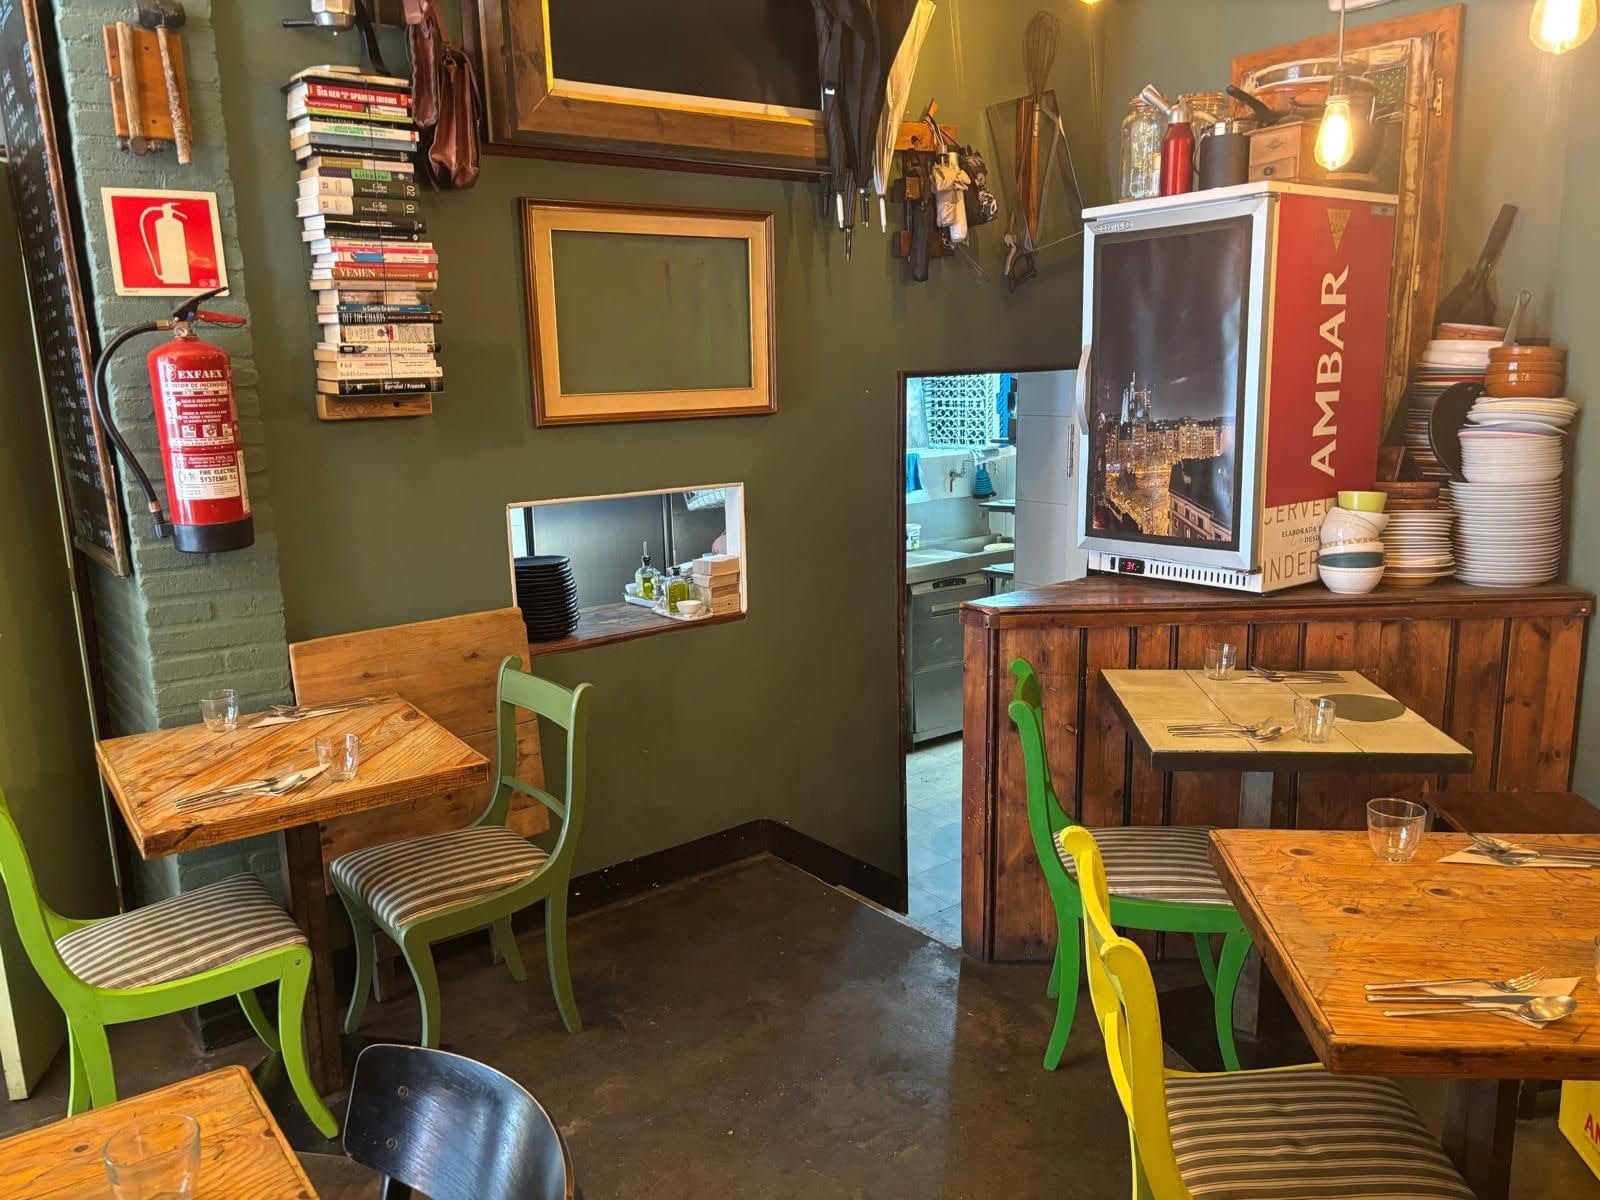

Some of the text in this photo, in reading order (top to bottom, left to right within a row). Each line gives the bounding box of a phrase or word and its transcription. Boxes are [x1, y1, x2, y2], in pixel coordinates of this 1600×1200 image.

[340, 268, 376, 277] YEMEN
[178, 370, 223, 379] EXFAEX
[1310, 264, 1349, 478] AMBAR
[200, 475, 228, 483] SYSTEMS
[1282, 525, 1316, 538] ELABORADA
